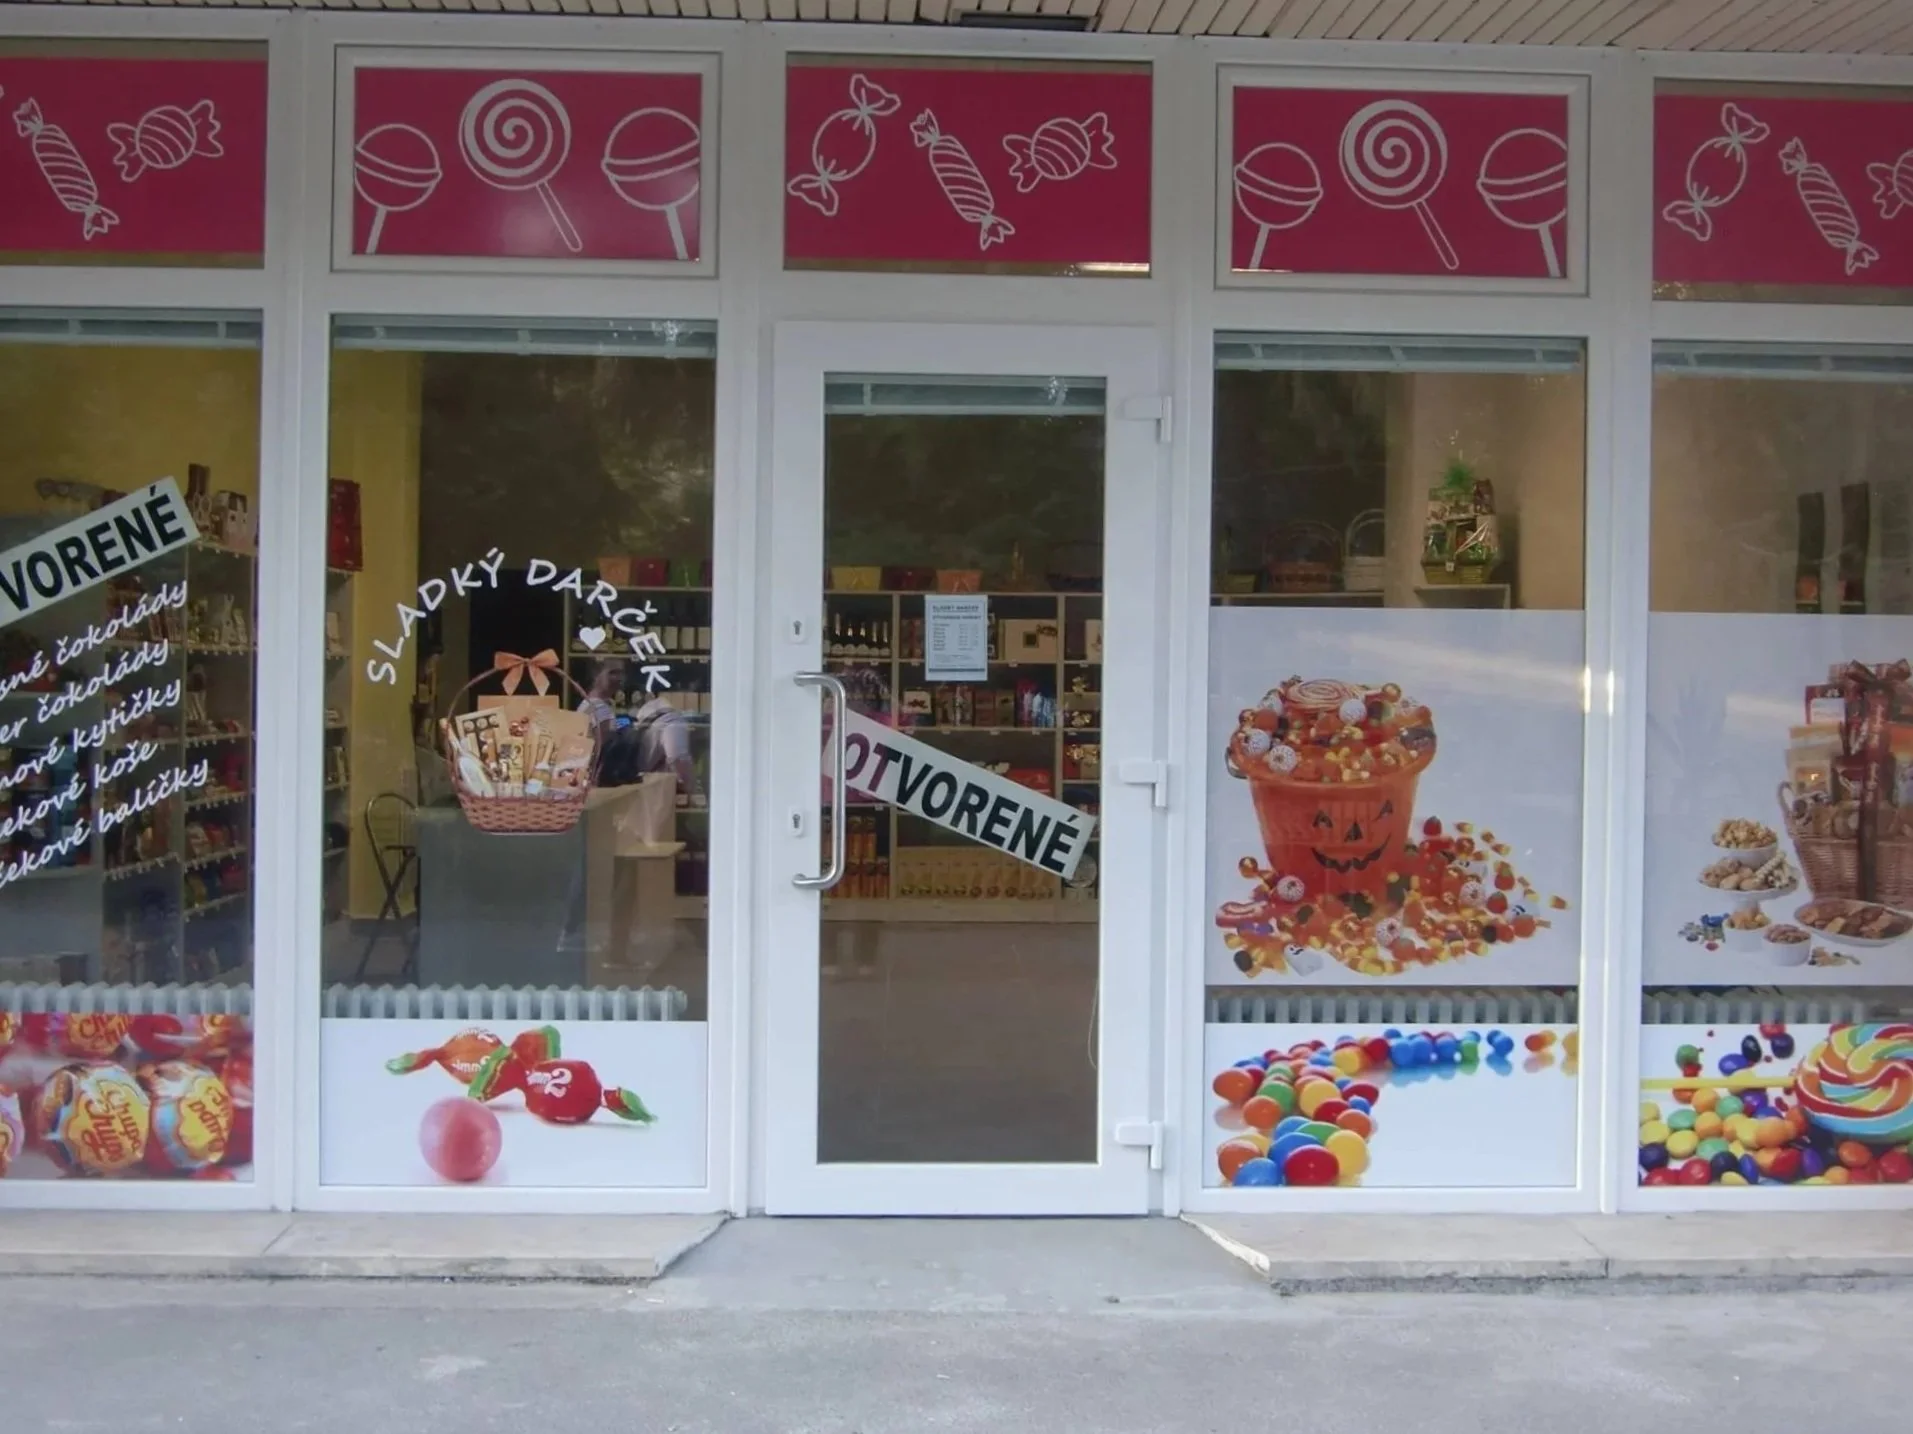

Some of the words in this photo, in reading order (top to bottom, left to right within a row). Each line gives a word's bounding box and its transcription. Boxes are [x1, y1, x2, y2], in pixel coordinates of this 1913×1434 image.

[0, 485, 187, 611] VORENÉ
[56, 580, 188, 666] čokolády
[366, 546, 504, 685] SLADKÝ
[525, 558, 671, 692] DARČEK
[37, 638, 169, 723] čokolády
[73, 679, 181, 753] kytičky
[94, 739, 159, 788] koše
[98, 759, 209, 833] balíčky
[844, 731, 1081, 873] OTVORENÉ
